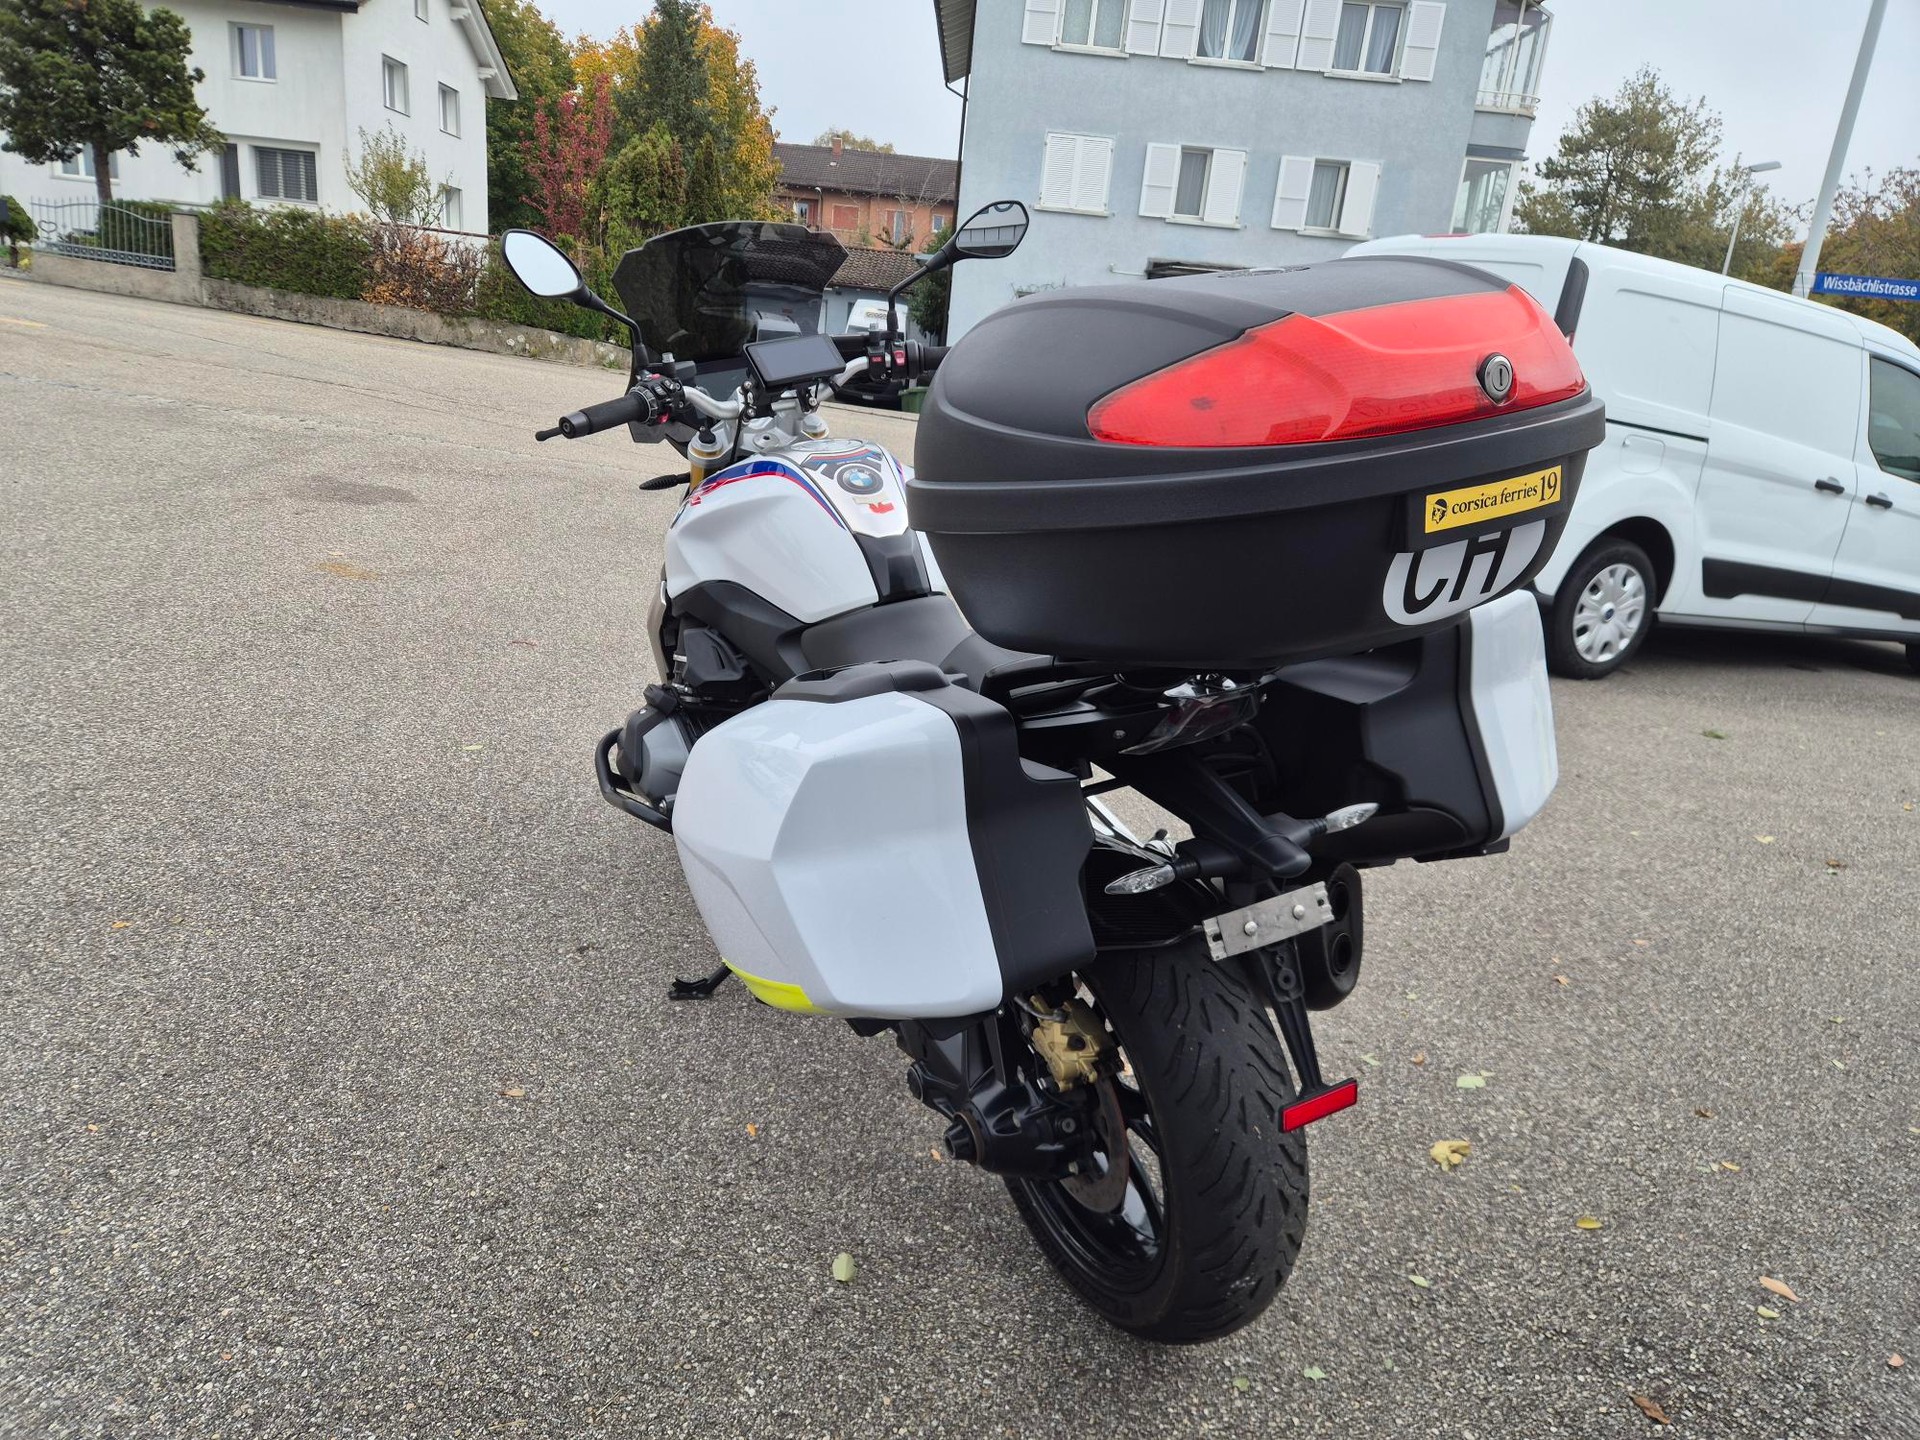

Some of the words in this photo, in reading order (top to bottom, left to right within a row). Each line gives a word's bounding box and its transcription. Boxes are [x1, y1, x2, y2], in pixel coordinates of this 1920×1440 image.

[1823, 276, 1918, 297] Wissbächlistrasse
[1451, 492, 1498, 515] corsica
[1500, 482, 1538, 505] ferries
[1538, 471, 1558, 502] 19
